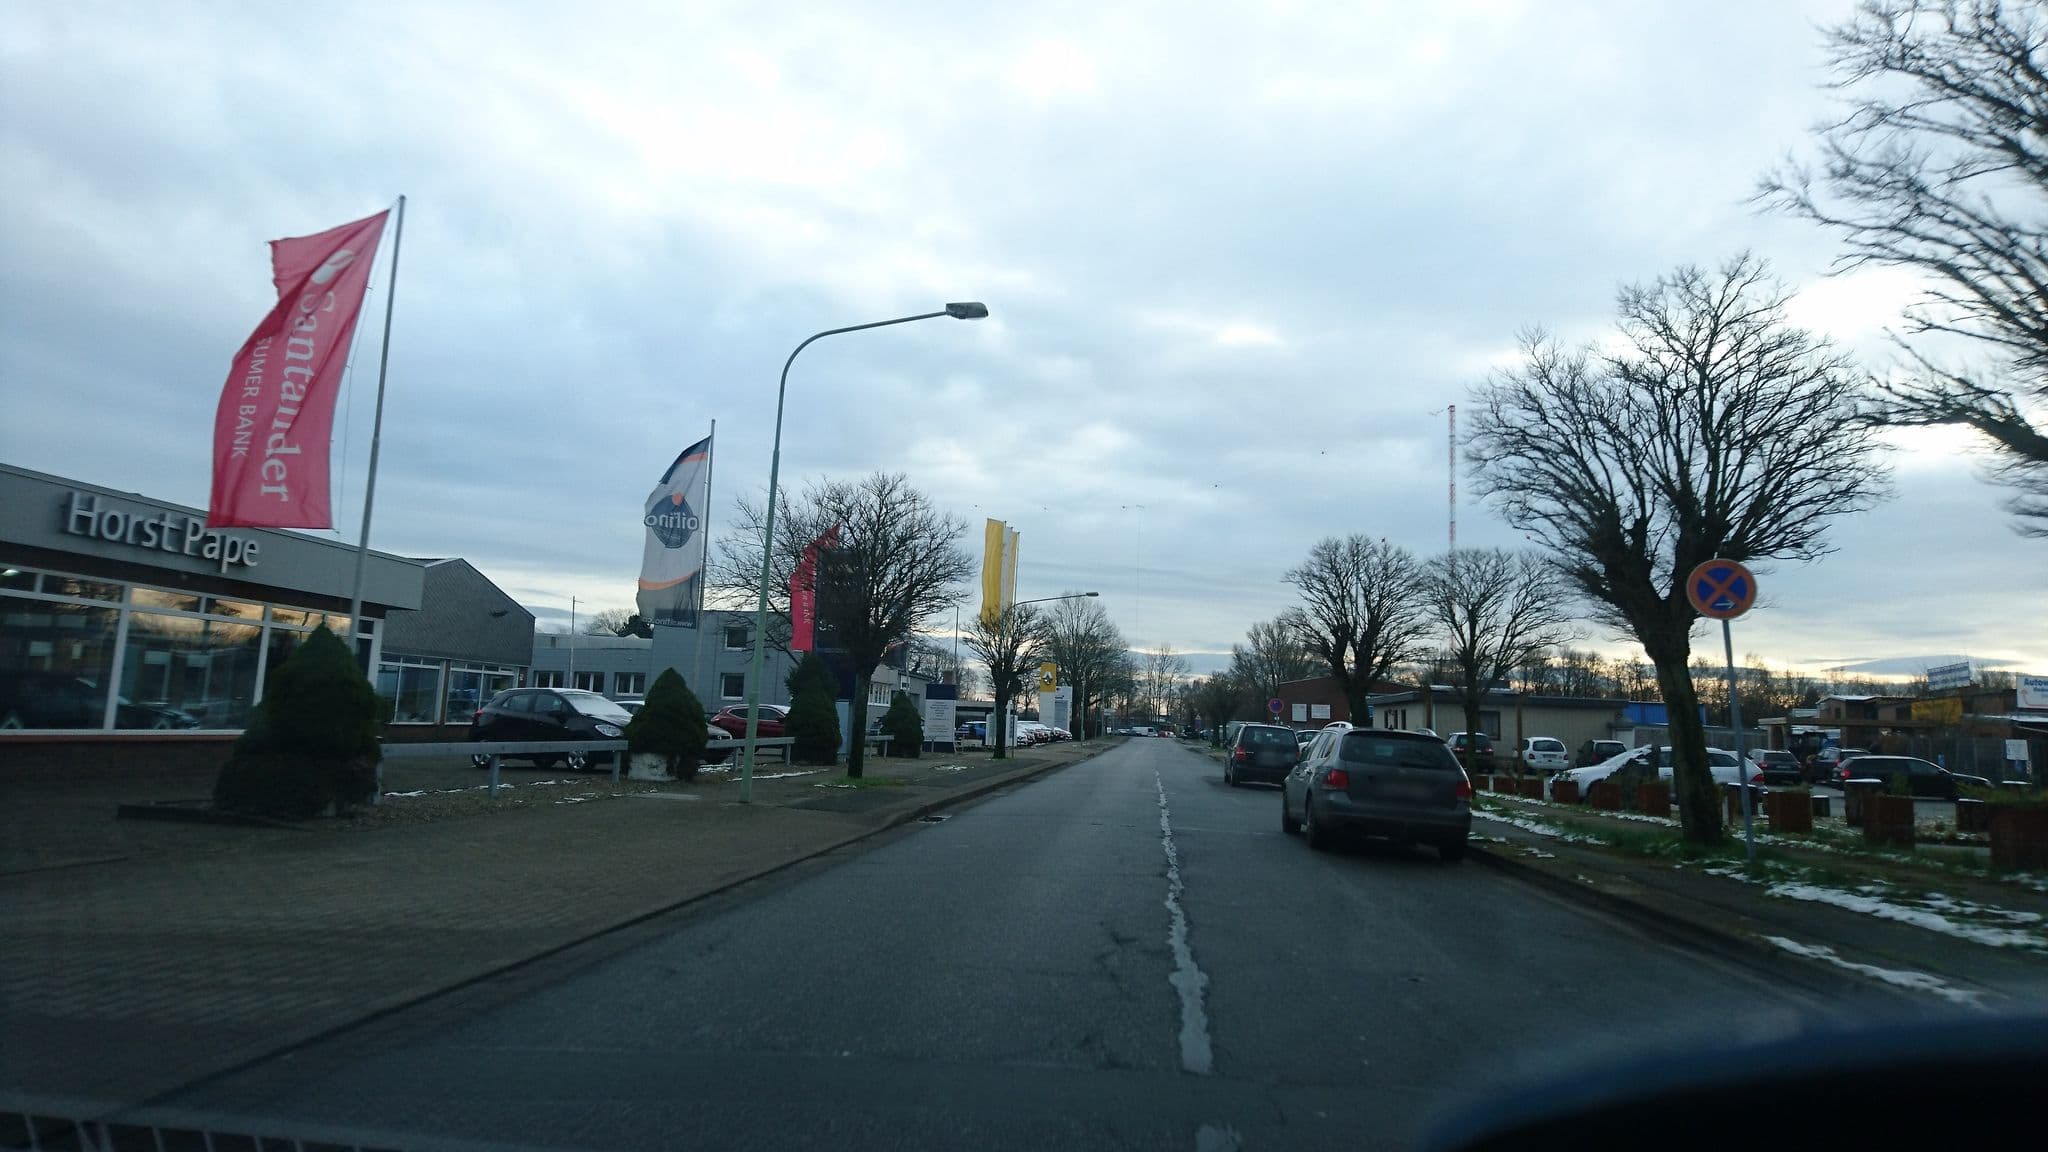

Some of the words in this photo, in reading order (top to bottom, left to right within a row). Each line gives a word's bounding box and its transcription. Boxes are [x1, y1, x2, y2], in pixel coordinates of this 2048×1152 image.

[231, 405, 256, 460] BANK
[260, 291, 335, 502] Santander
[68, 491, 178, 552] Horst
[184, 517, 259, 573] Pape
